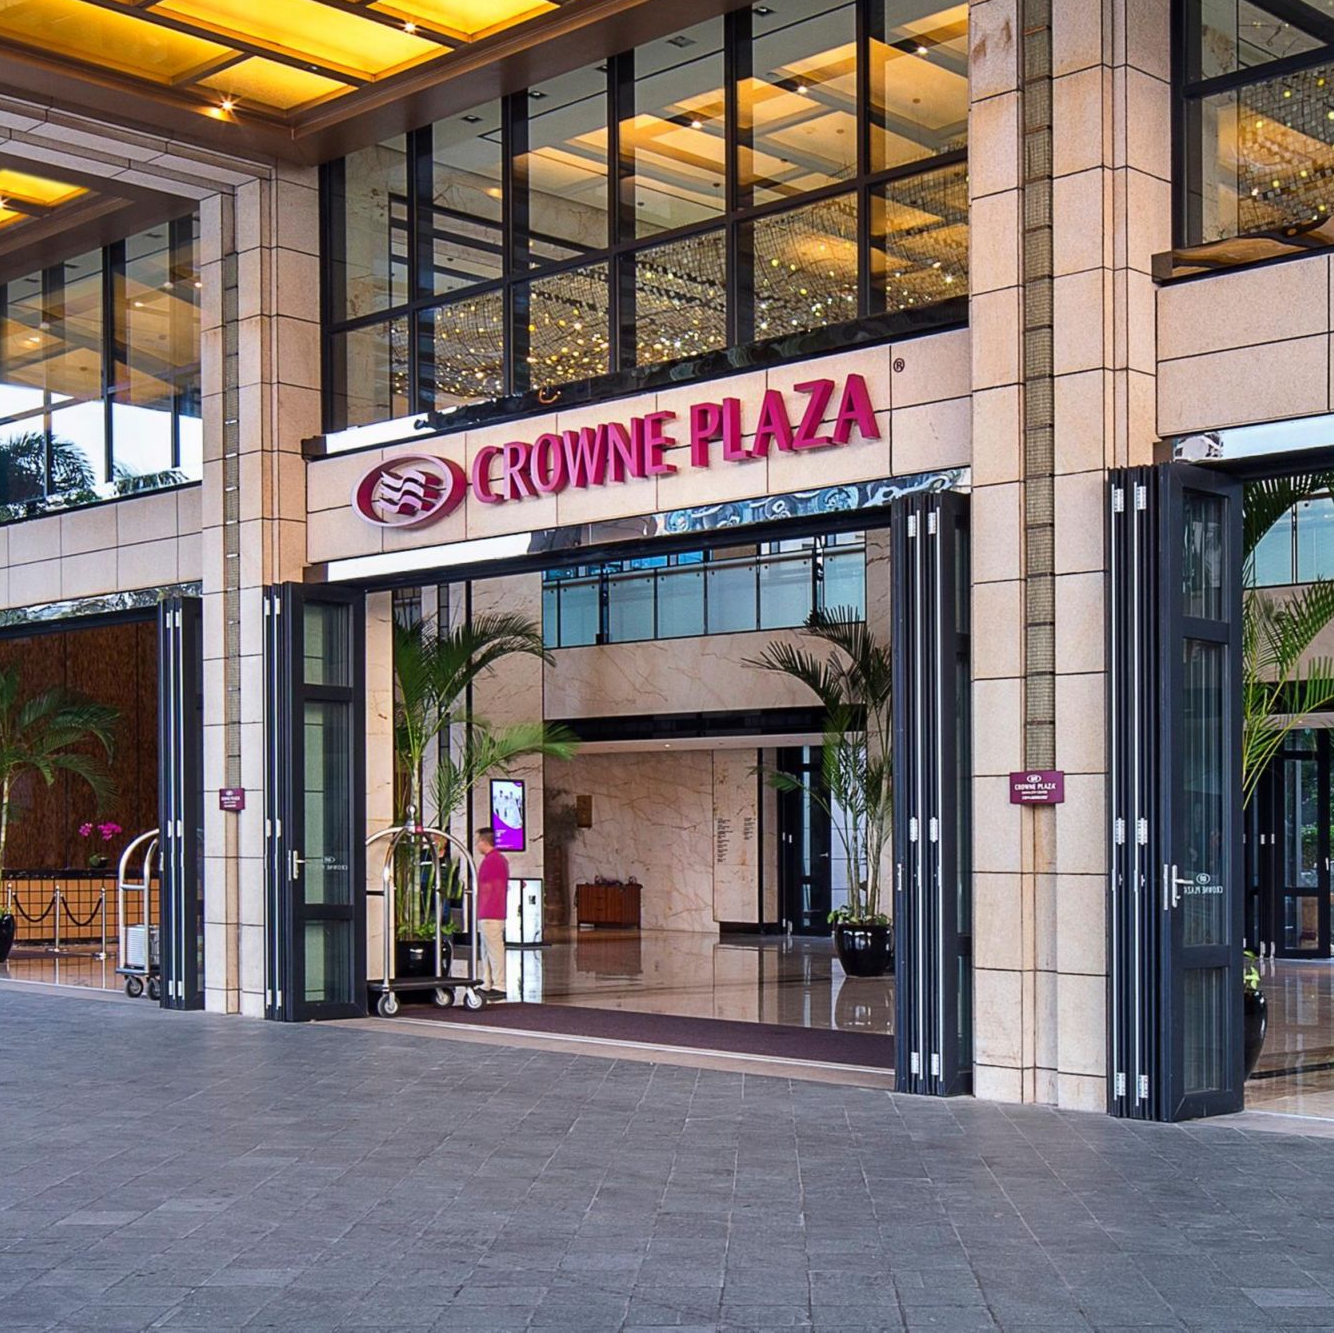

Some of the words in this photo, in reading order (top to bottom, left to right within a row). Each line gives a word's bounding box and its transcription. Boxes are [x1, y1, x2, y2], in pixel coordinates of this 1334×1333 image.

[472, 410, 677, 503] CROWNE
[690, 373, 881, 467] PLAZA
[1014, 783, 1036, 791] CROWNE
[1037, 782, 1056, 790] PLAZA
